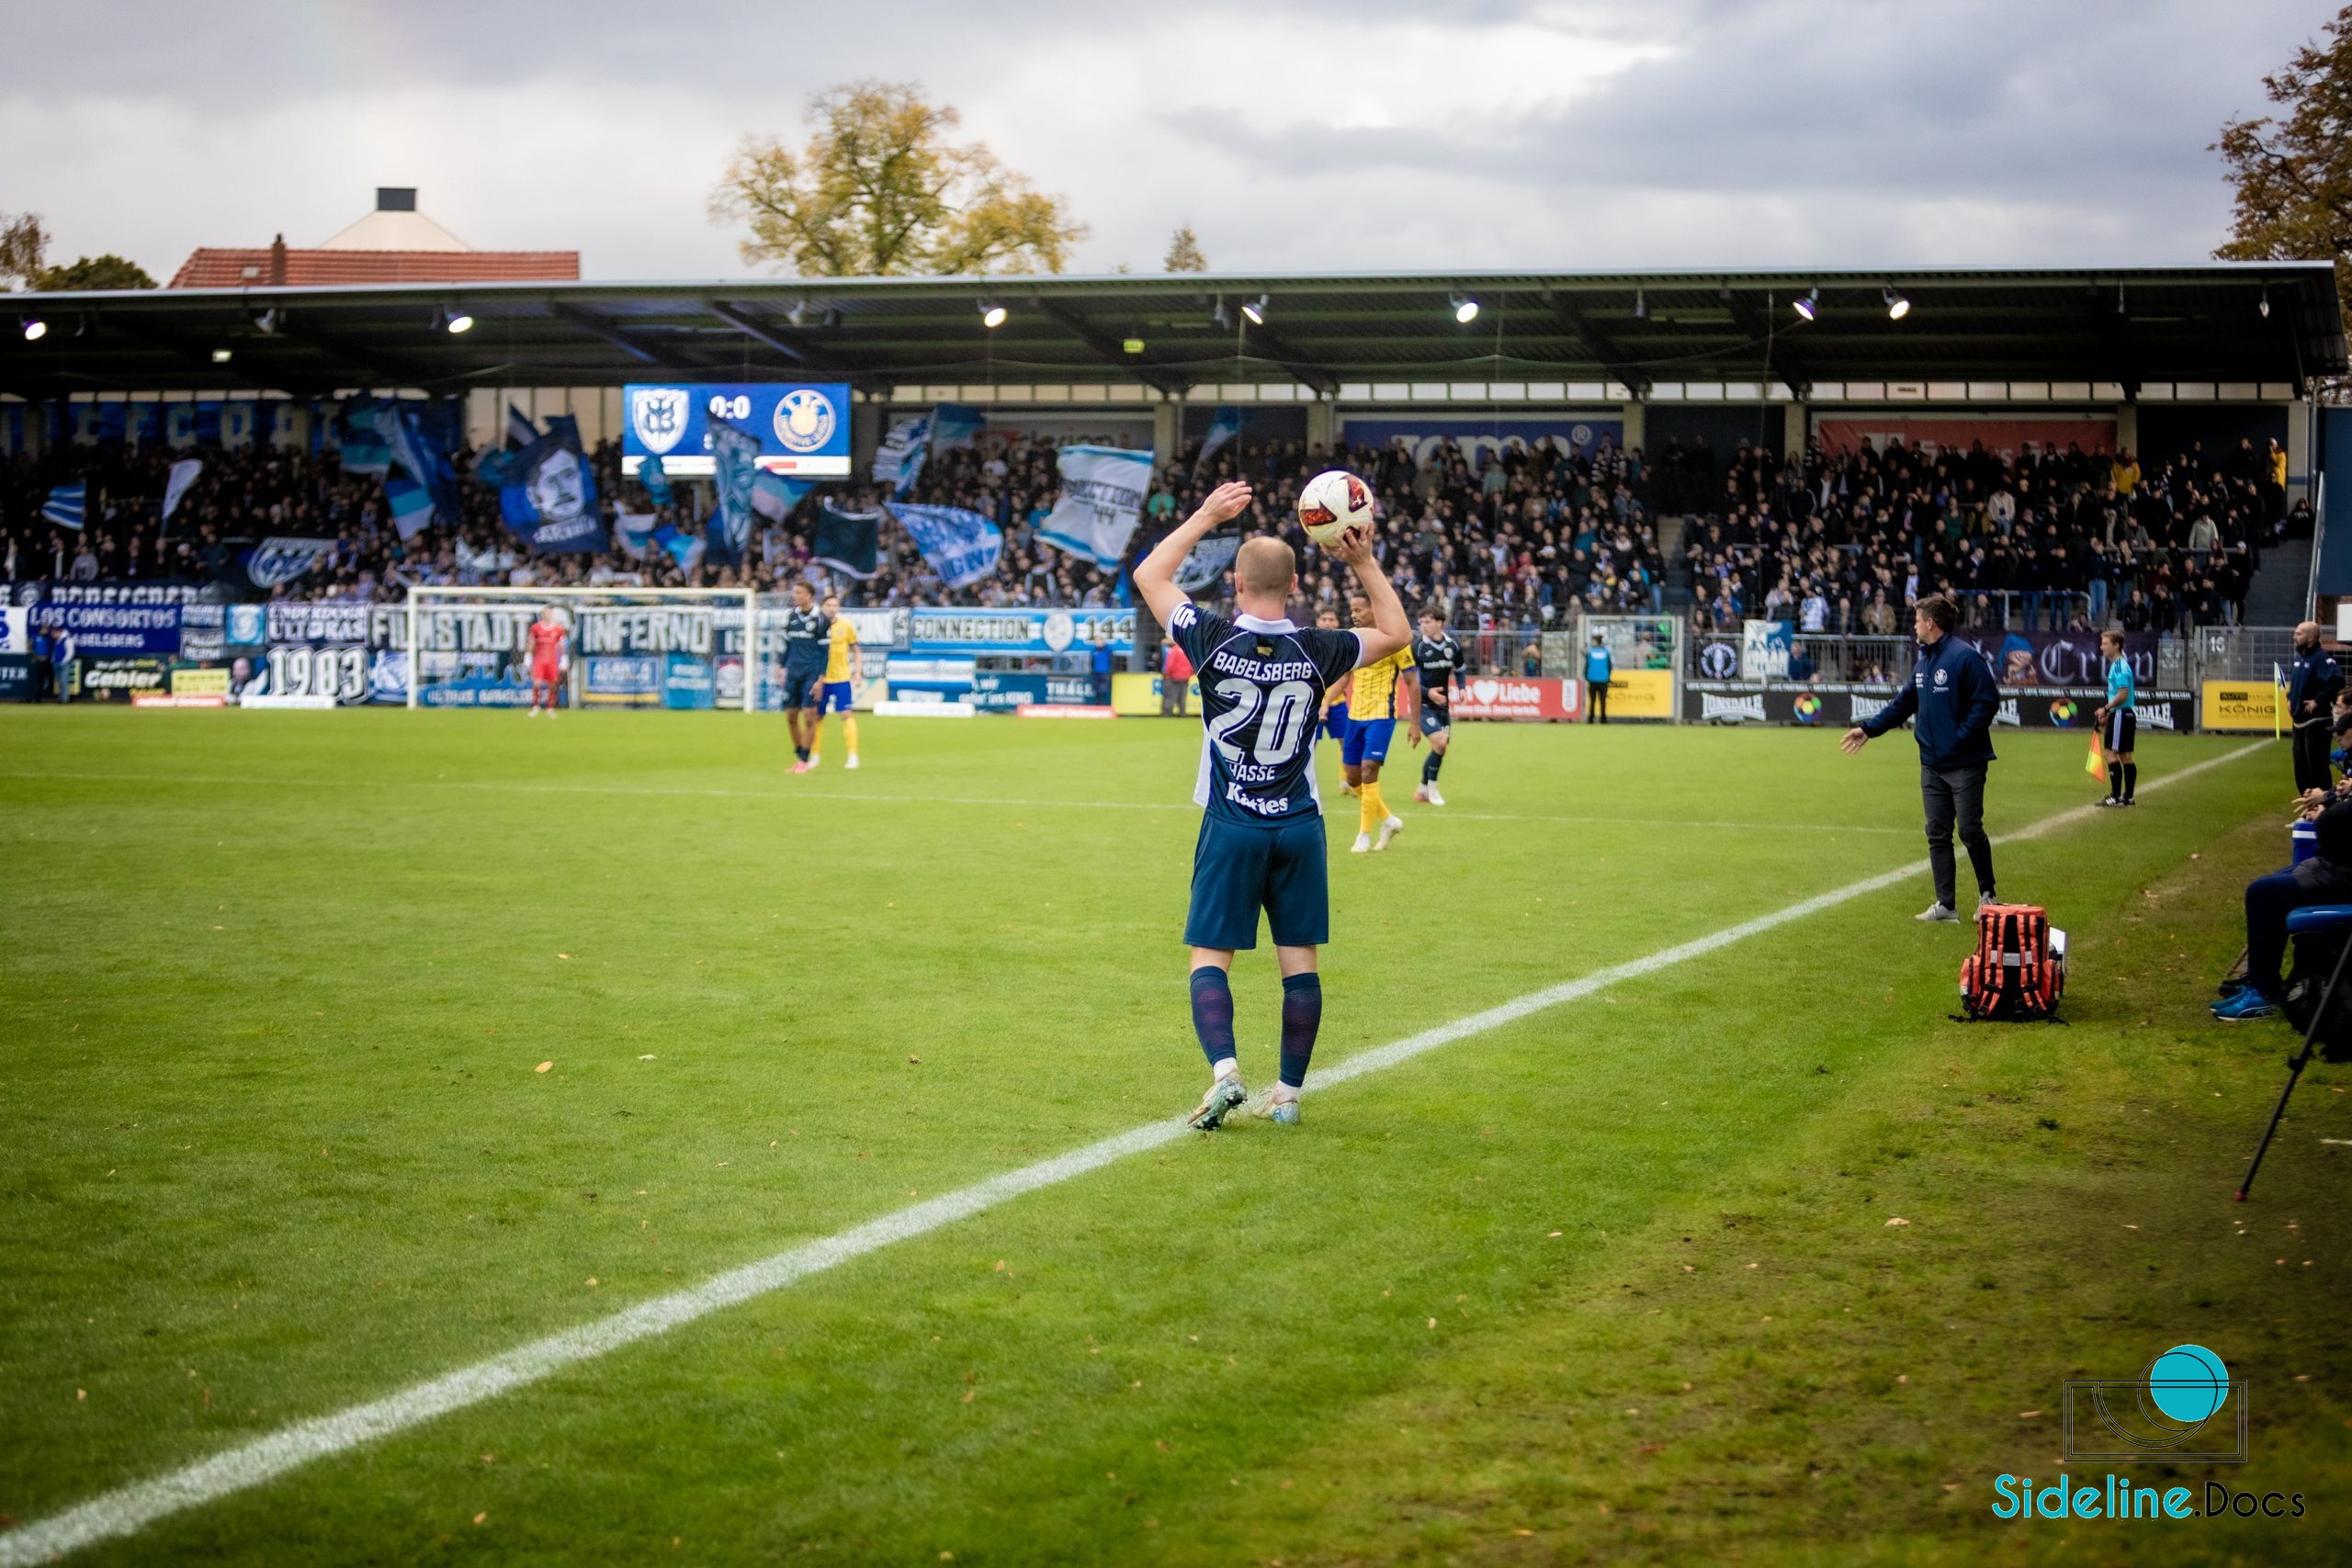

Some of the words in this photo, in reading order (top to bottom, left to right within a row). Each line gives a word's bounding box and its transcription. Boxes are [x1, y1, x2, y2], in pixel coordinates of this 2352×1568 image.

[29, 606, 66, 626] LOS
[912, 616, 1032, 641] CONNECTION
[582, 612, 711, 654] INFERNO
[85, 669, 162, 688] Gabler
[267, 646, 368, 706] 1903
[1213, 651, 1312, 681] BABELSBERG
[1498, 682, 1541, 704] Liebe
[1702, 693, 1766, 721] LONSDALE
[2219, 702, 2276, 714] KÖNIG
[1208, 678, 1315, 765] 20
